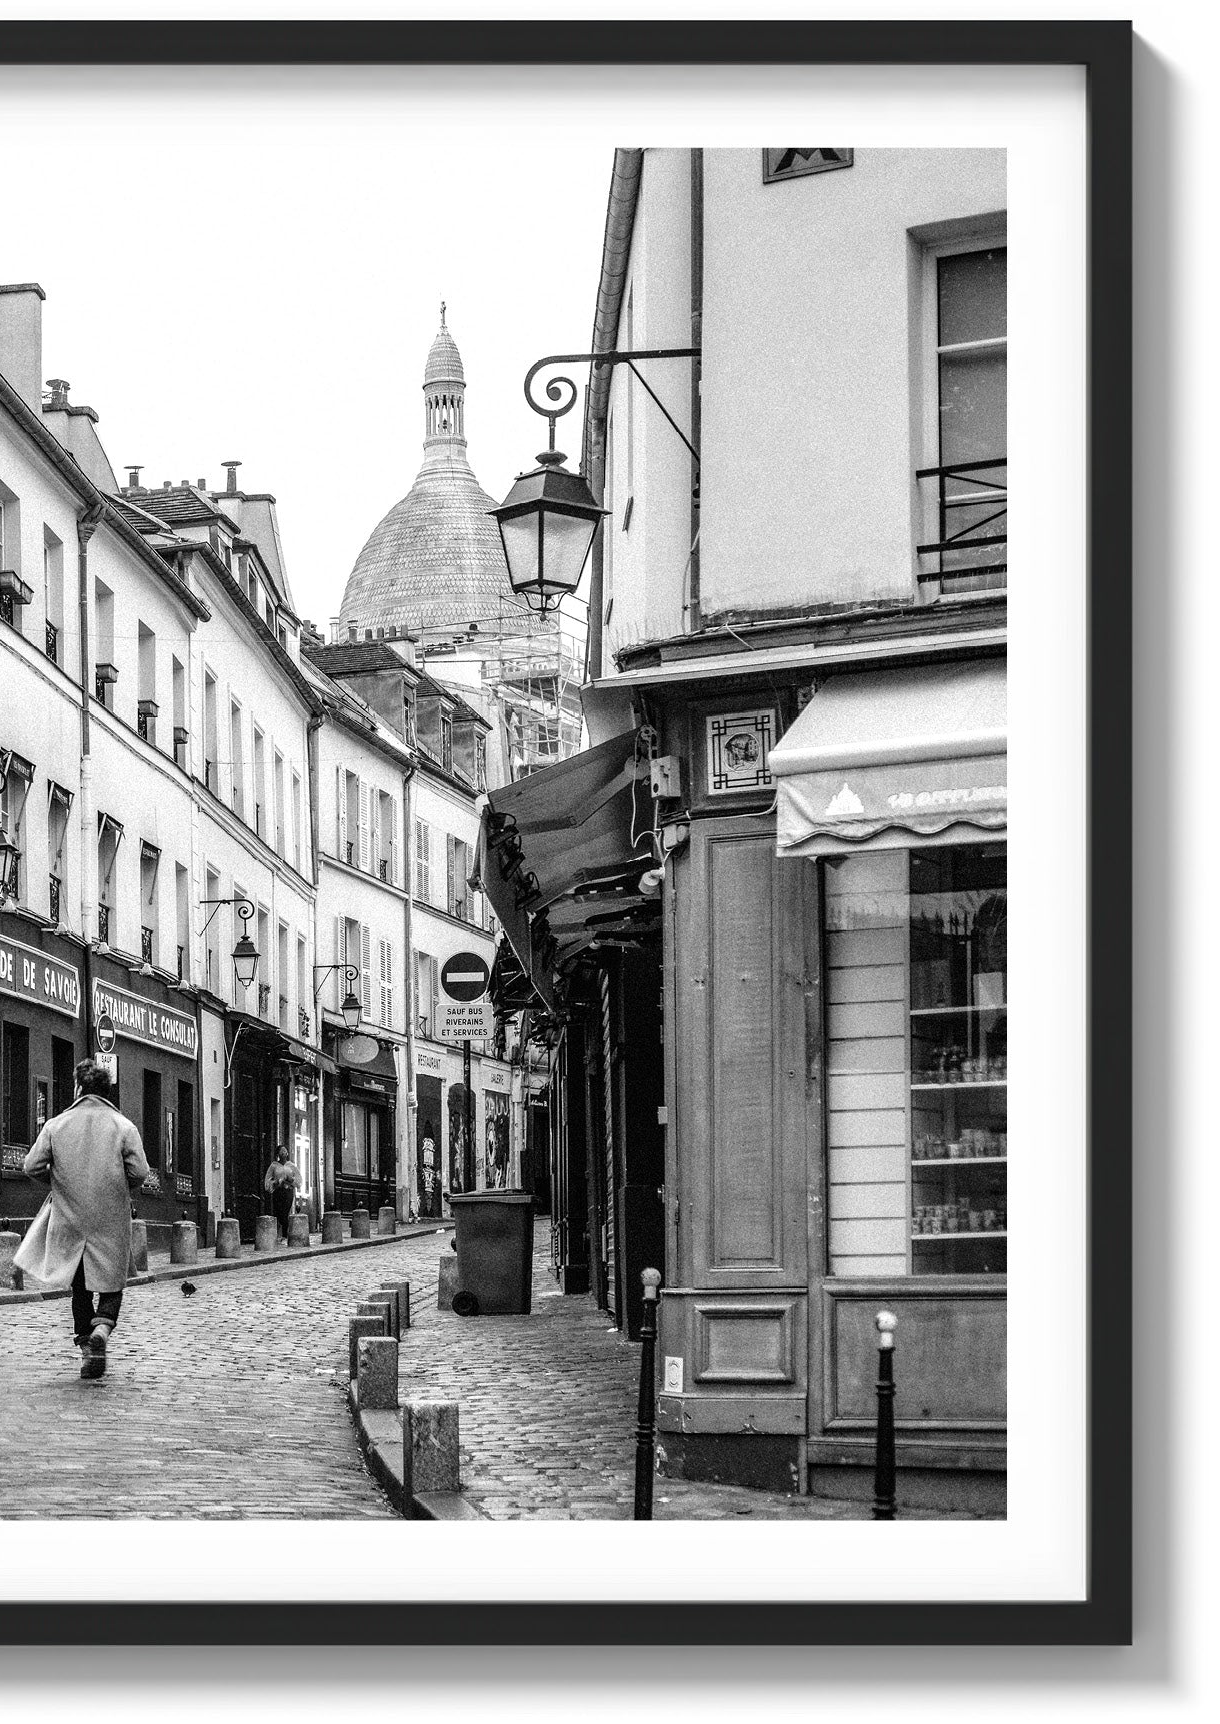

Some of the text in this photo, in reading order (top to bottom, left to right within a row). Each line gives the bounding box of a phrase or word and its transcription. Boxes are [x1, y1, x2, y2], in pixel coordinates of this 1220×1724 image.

[23, 956, 36, 990] DE
[44, 966, 78, 1007] SAVOIE
[447, 1007, 483, 1016] SAUF BUS
[95, 990, 195, 1050] RESTAURANT LE CONSULAT
[445, 1017, 484, 1026] RIVERAINS
[441, 1027, 488, 1037] ET SERVICES
